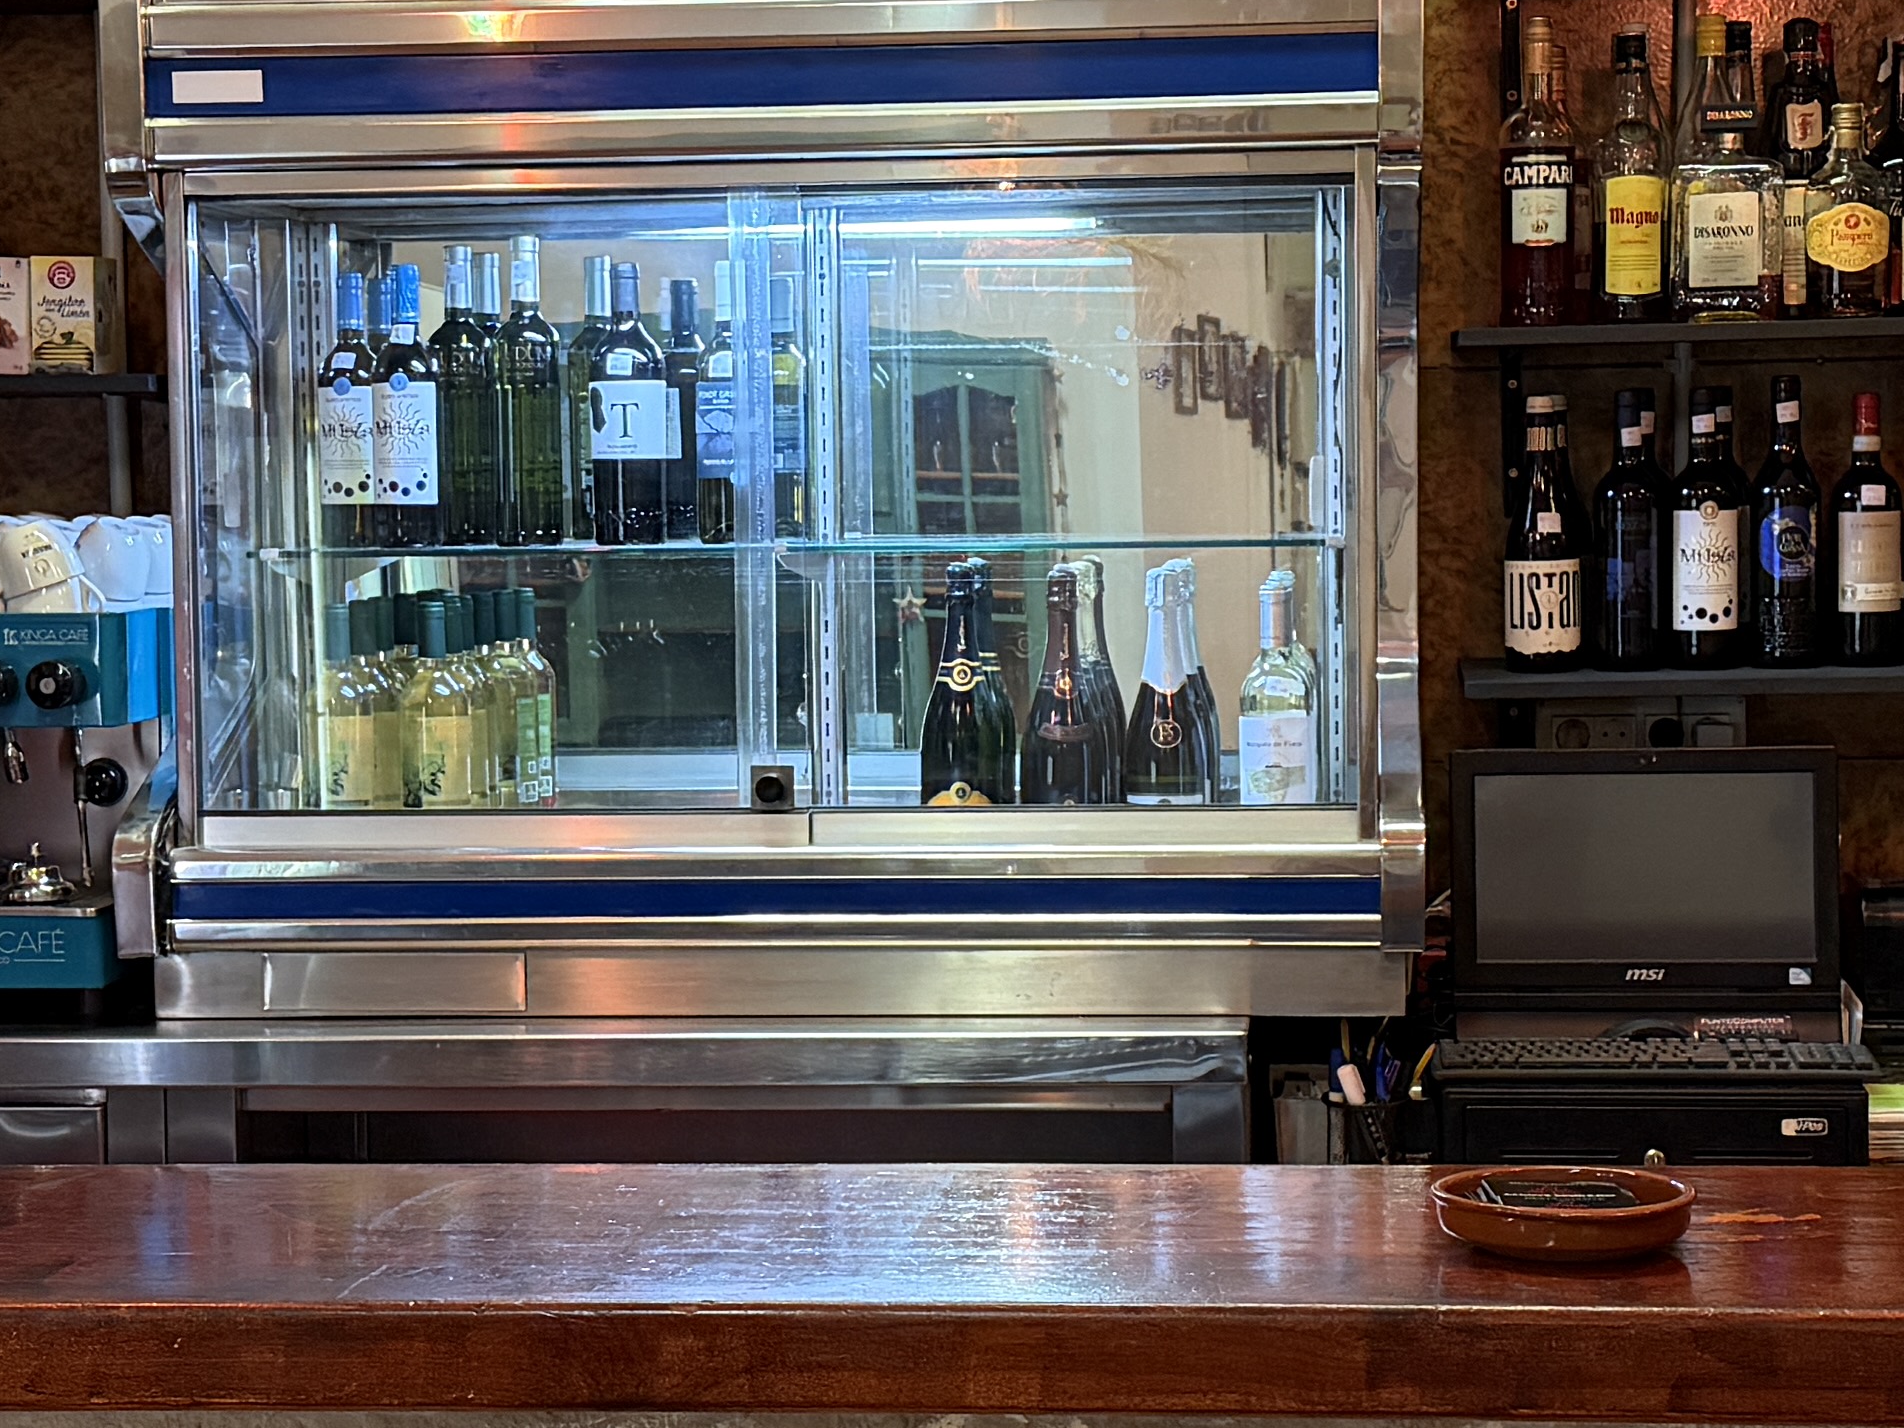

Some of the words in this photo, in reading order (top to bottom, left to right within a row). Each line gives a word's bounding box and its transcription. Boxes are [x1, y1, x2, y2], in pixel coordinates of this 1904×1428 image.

[1706, 110, 1753, 120] DISARONNO
[1504, 164, 1573, 186] CAMPARI
[1609, 207, 1659, 228] Magno
[1694, 225, 1754, 239] DISARONNO
[610, 402, 639, 439] T
[20, 630, 57, 641] KINGA
[59, 627, 89, 641] CAFÉ
[1625, 968, 1665, 981] msi
